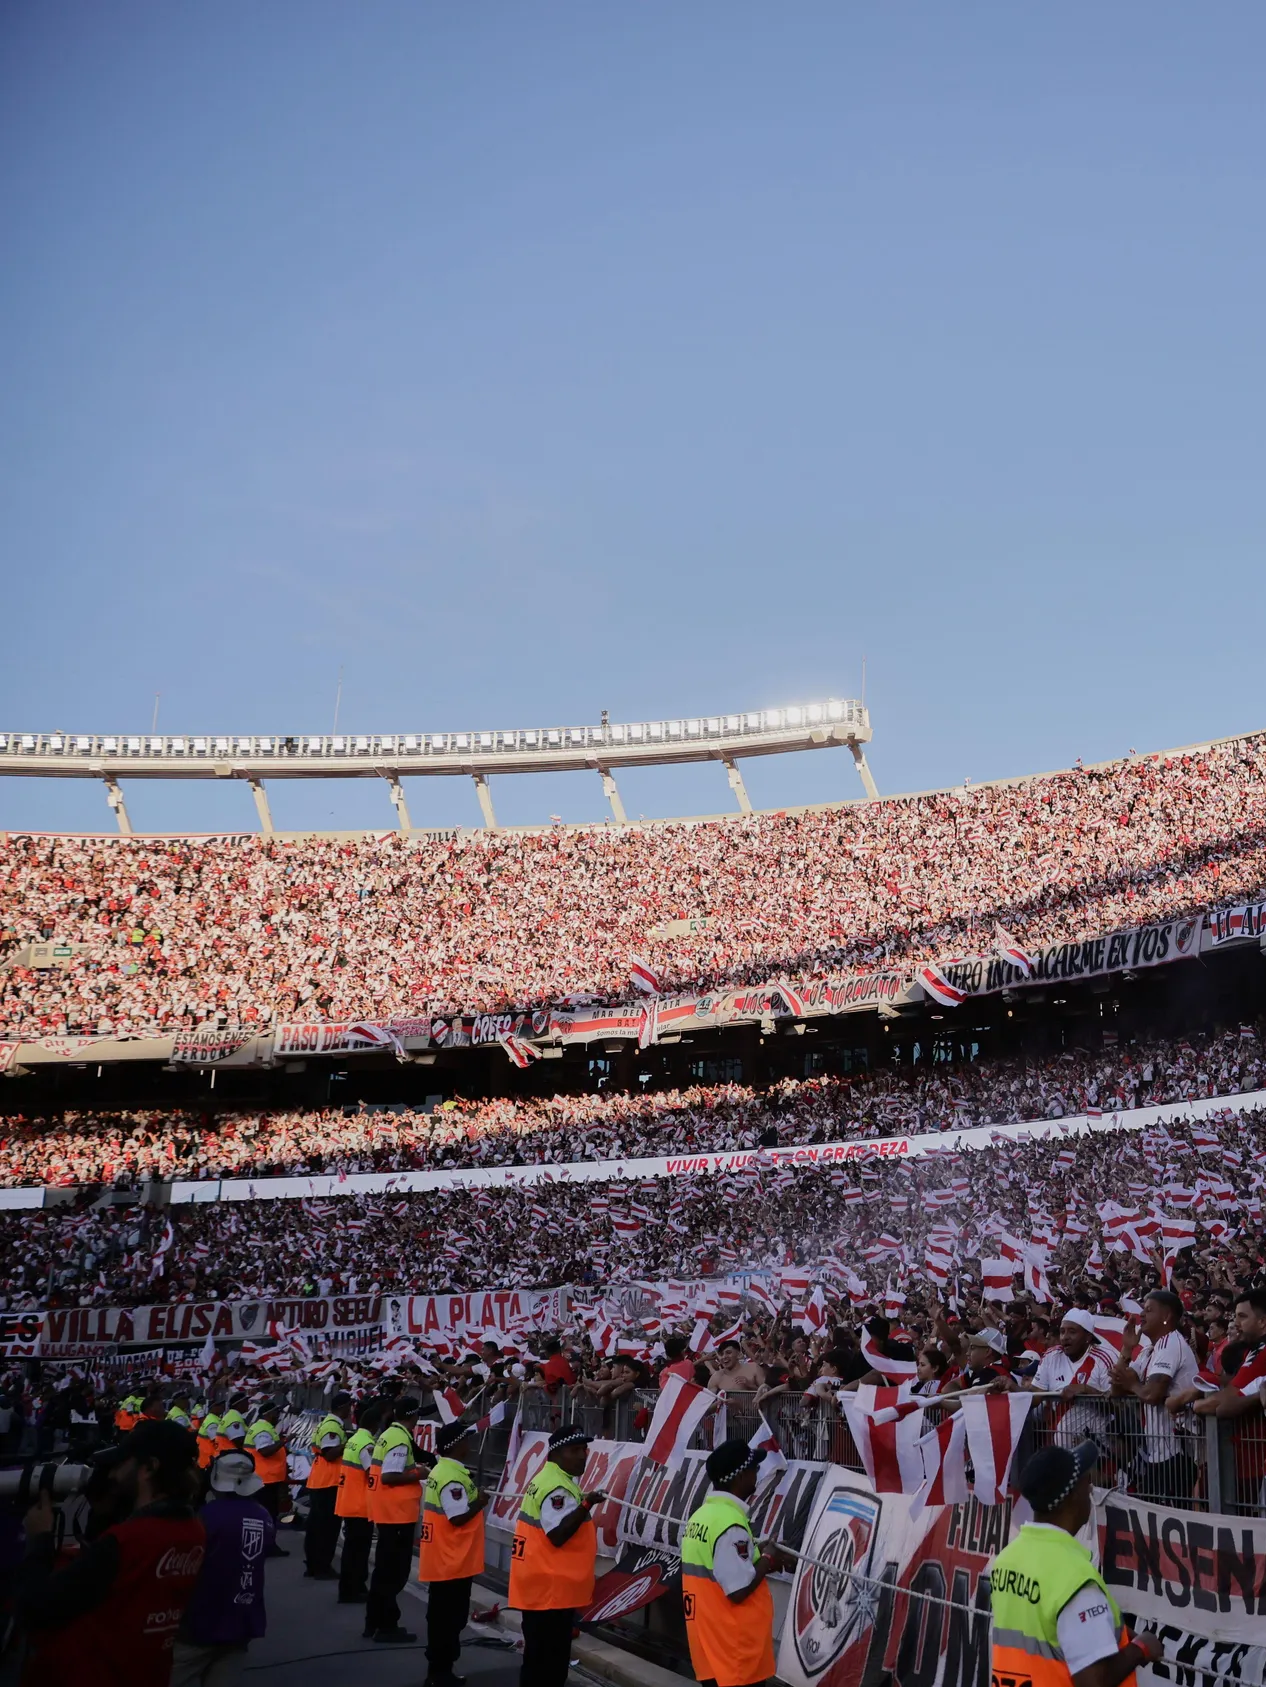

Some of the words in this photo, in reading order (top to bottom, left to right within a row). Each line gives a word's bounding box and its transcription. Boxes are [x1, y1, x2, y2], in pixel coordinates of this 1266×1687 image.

[1216, 909, 1234, 942] EL
[1107, 930, 1132, 970] EN
[1132, 925, 1172, 966] VOS
[592, 1010, 613, 1019] MAR
[622, 1009, 640, 1017] DEL
[657, 999, 680, 1012] LATA
[742, 992, 766, 1015] LOS
[830, 975, 898, 1010] TORCUATO
[175, 1033, 222, 1047] ESTAMOS
[280, 1026, 319, 1051] PASO
[666, 1157, 708, 1173] VIVIR
[714, 1157, 723, 1169] Y
[49, 1308, 135, 1343] VILLA
[147, 1304, 234, 1340] ELISA
[267, 1299, 329, 1329] ARTURO
[407, 1298, 440, 1335] LA
[449, 1293, 523, 1332] PLATA
